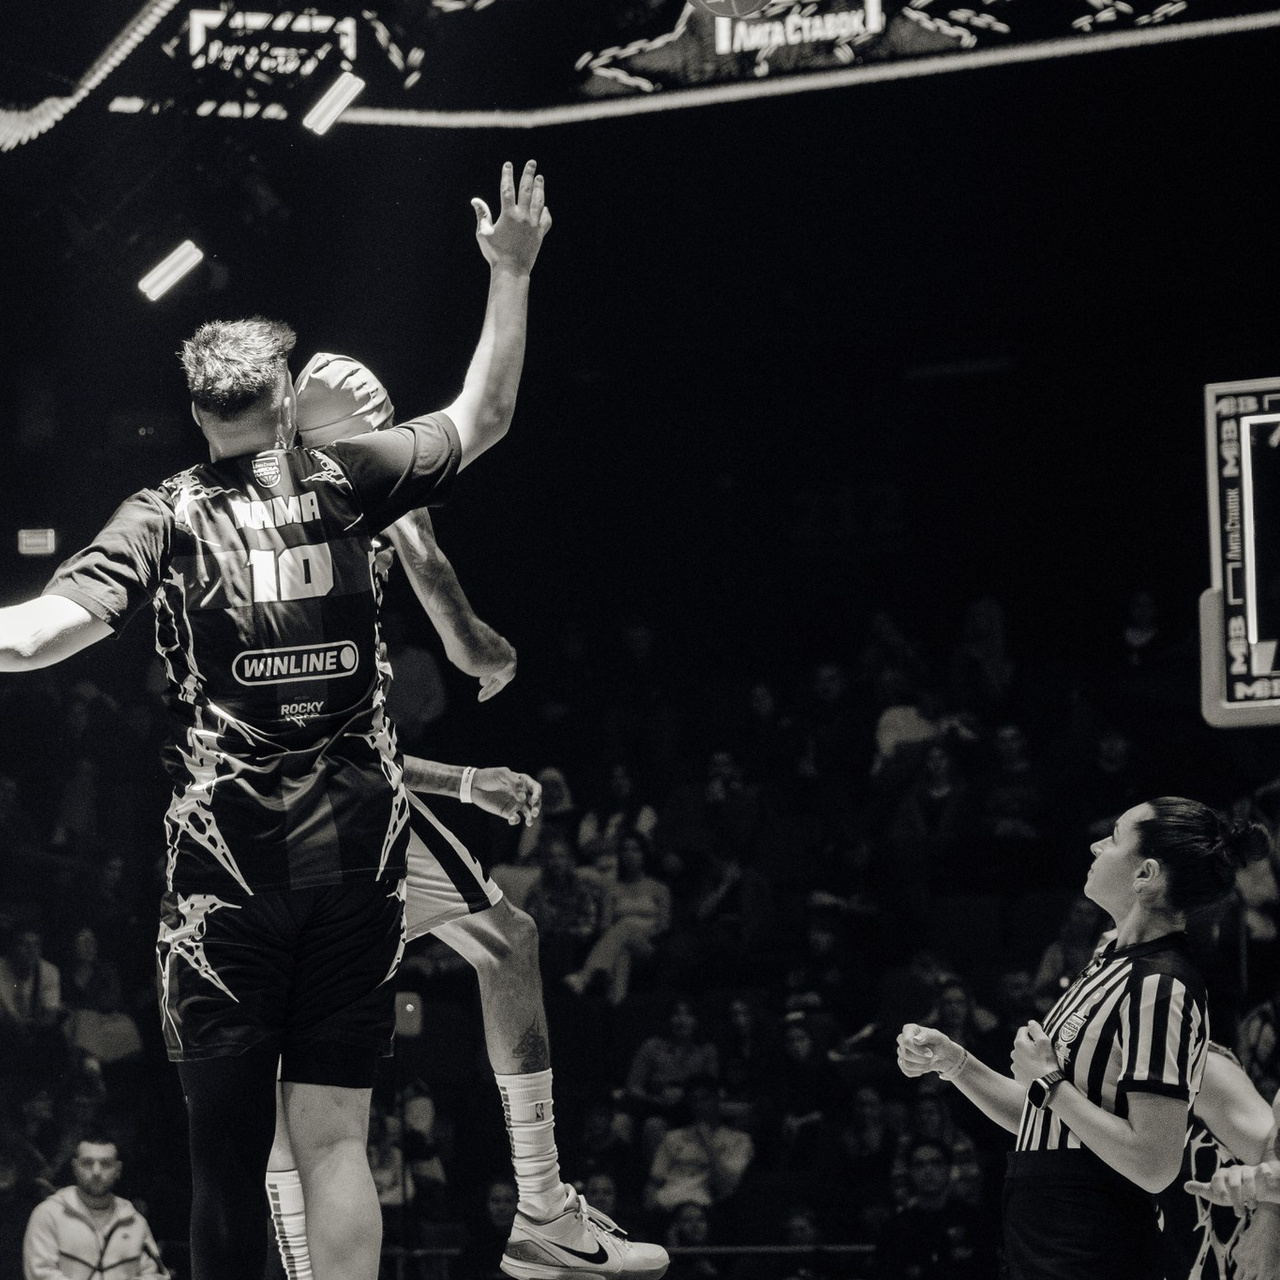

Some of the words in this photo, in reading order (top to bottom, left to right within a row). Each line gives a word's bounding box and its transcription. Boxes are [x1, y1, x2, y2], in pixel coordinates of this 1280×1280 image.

[228, 491, 322, 530] NAMA
[248, 542, 334, 603] 10
[244, 650, 338, 678] WINLINE
[281, 701, 324, 716] ROCKY
